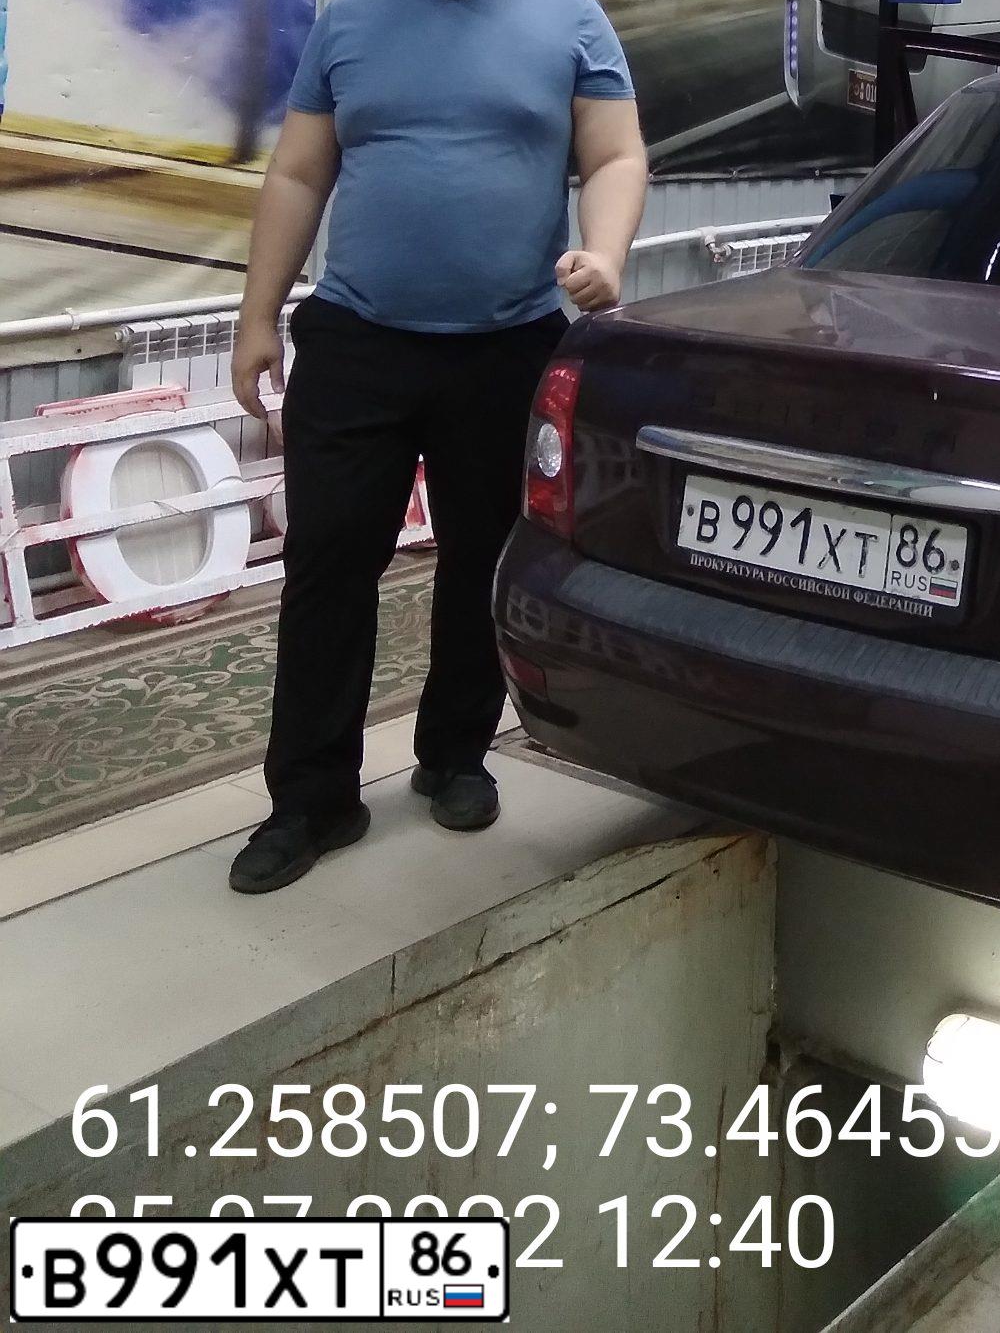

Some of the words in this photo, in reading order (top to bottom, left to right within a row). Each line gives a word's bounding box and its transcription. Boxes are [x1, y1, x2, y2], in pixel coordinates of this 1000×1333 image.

[695, 494, 879, 578] В991ХТ
[895, 524, 946, 574] 86
[689, 553, 765, 582] ПРОКУРАТУРА
[767, 570, 851, 600] РОССИЙСКОЙ
[852, 590, 934, 618] ФЕДЕРАЦИИ
[891, 571, 928, 592] RUS
